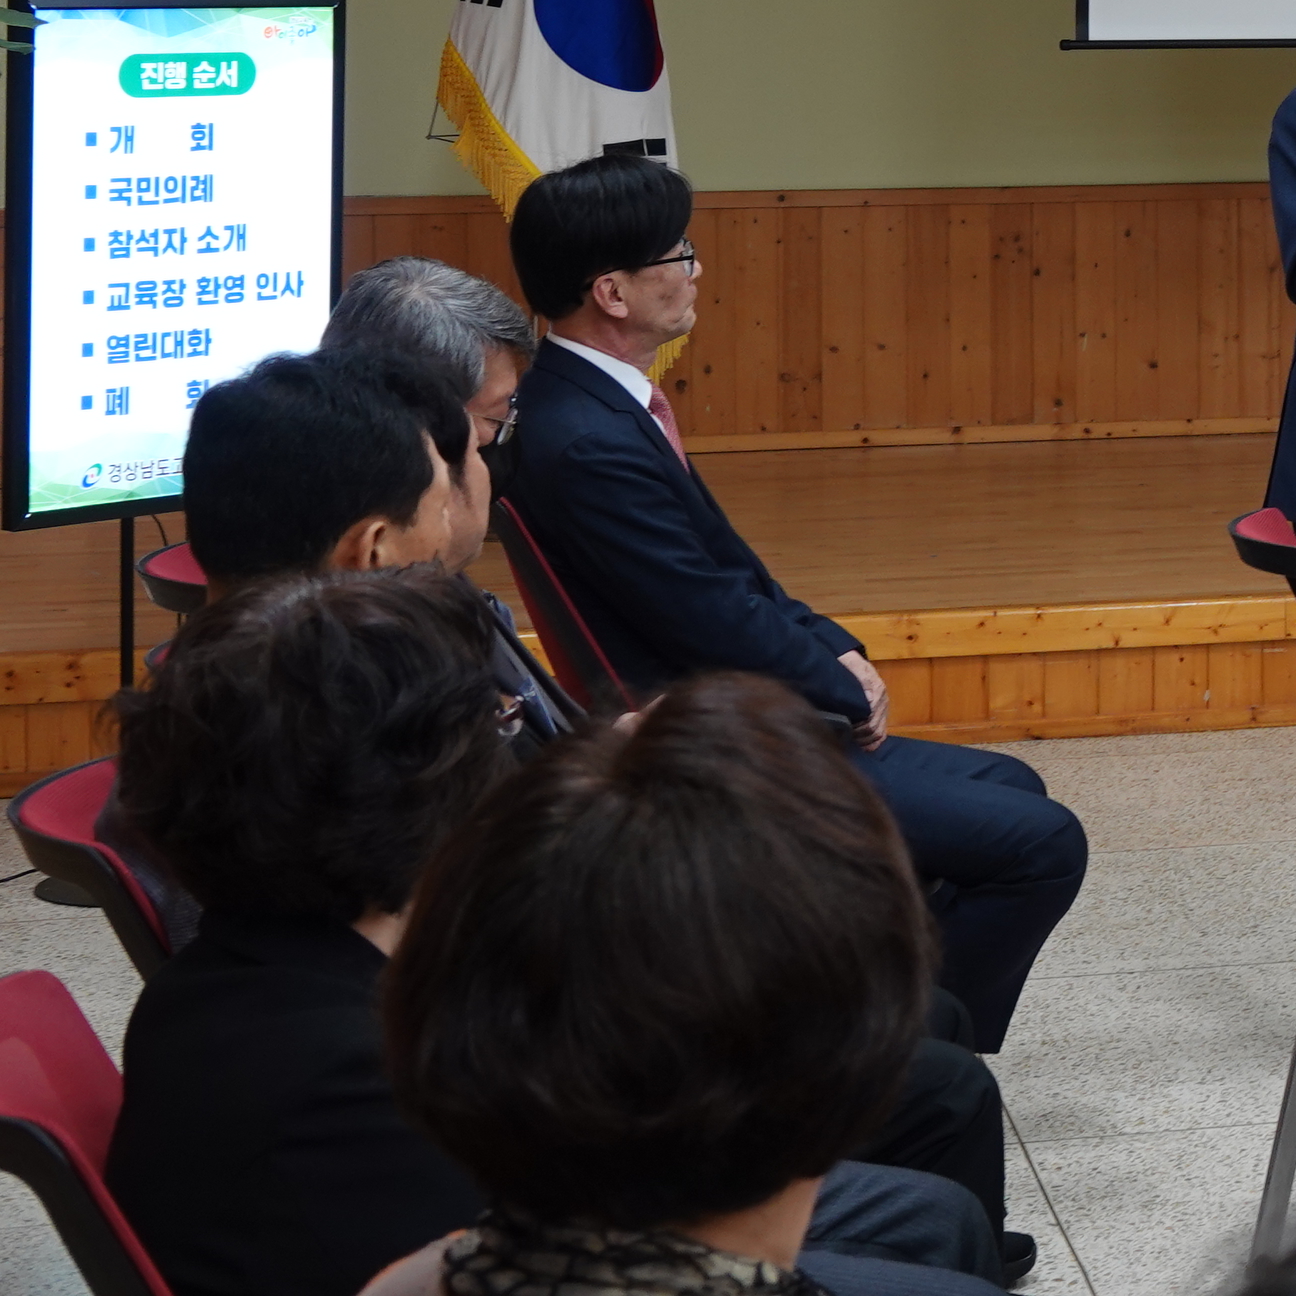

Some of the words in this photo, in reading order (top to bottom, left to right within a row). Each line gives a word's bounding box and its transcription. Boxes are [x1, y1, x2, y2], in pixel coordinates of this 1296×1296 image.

[140, 61, 187, 90] 진행
[192, 60, 239, 89] 순서
[109, 174, 214, 206] 국민의례
[108, 227, 187, 259] 참석자
[197, 223, 247, 254] 소개
[106, 278, 187, 311] 교육장
[196, 274, 245, 306] 환영
[256, 270, 304, 301] 인사
[106, 328, 212, 364] 열린대화
